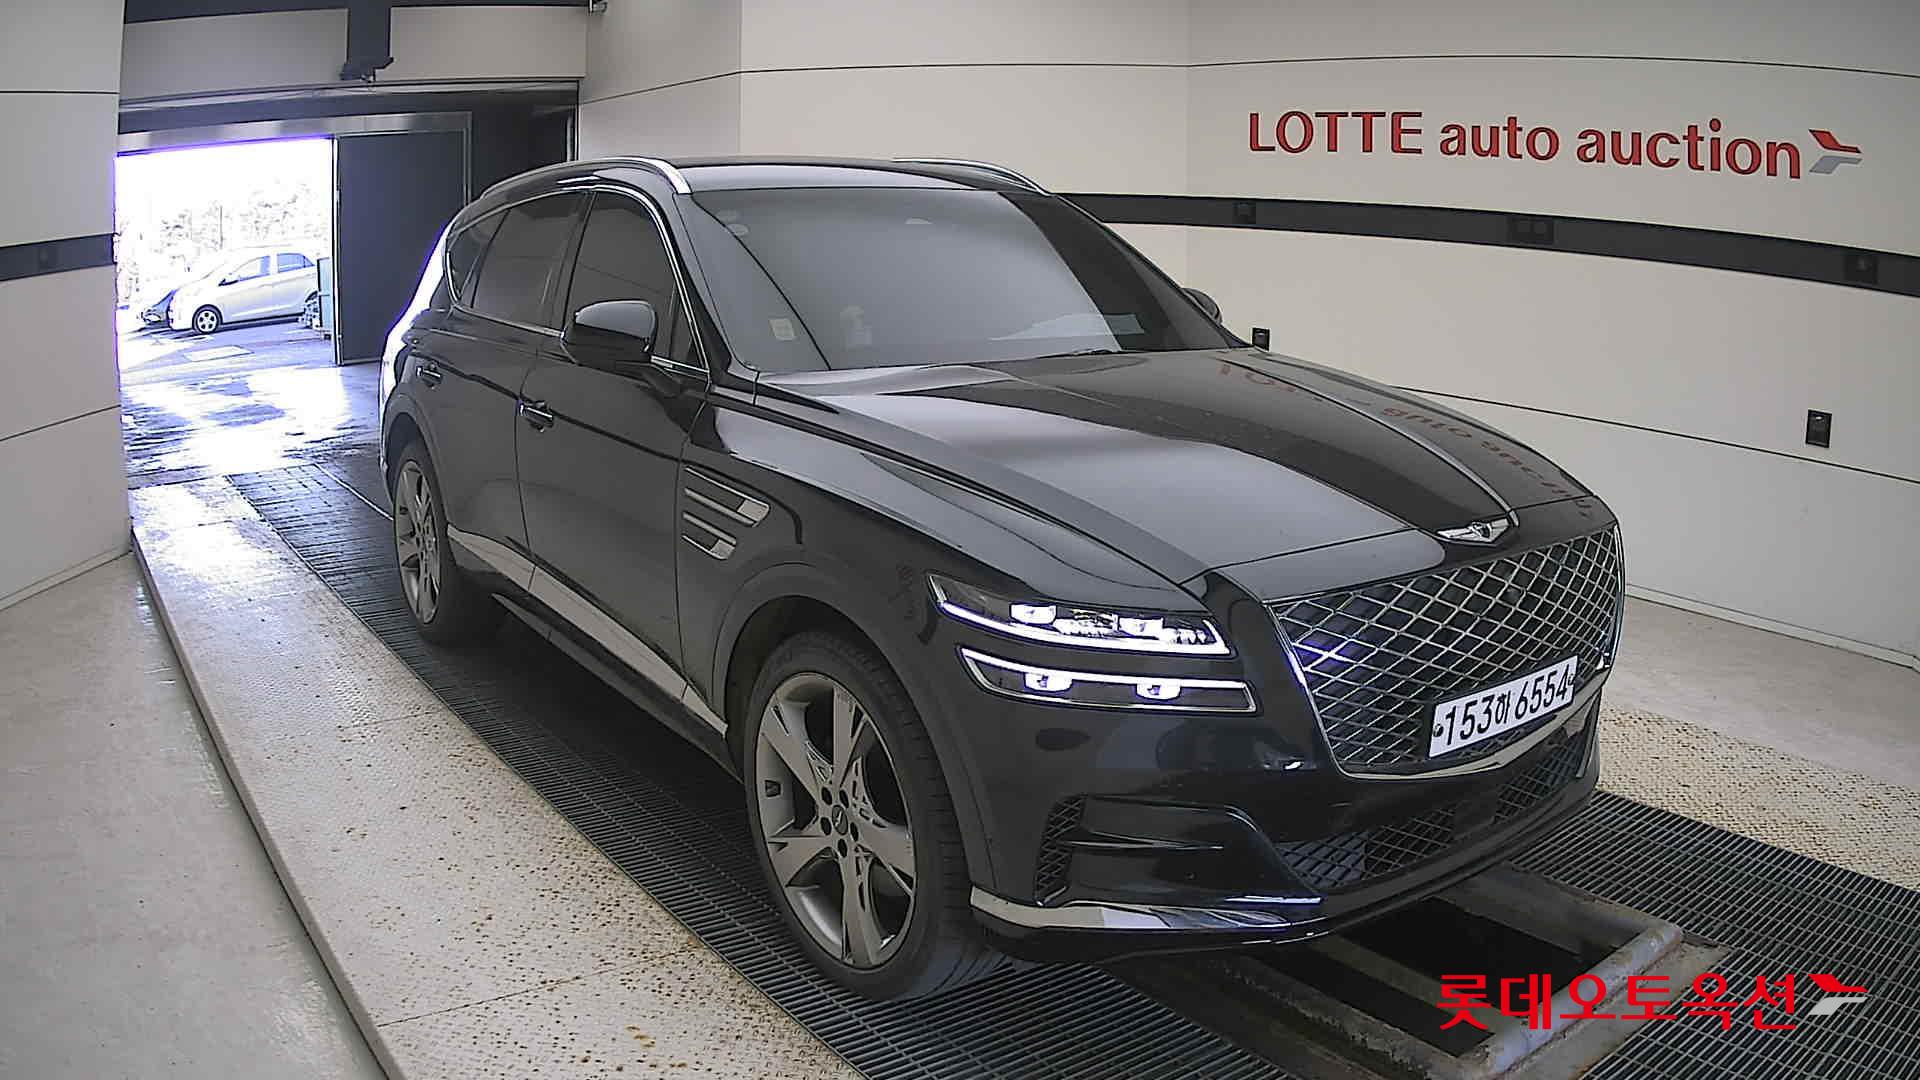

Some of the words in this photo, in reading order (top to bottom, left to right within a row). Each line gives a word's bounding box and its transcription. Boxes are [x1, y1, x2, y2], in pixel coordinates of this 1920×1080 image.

[1248, 111, 1424, 155] LOTTE
[1440, 116, 1560, 161] auto
[1576, 118, 1802, 180] auction
[1514, 663, 1569, 721] 6554
